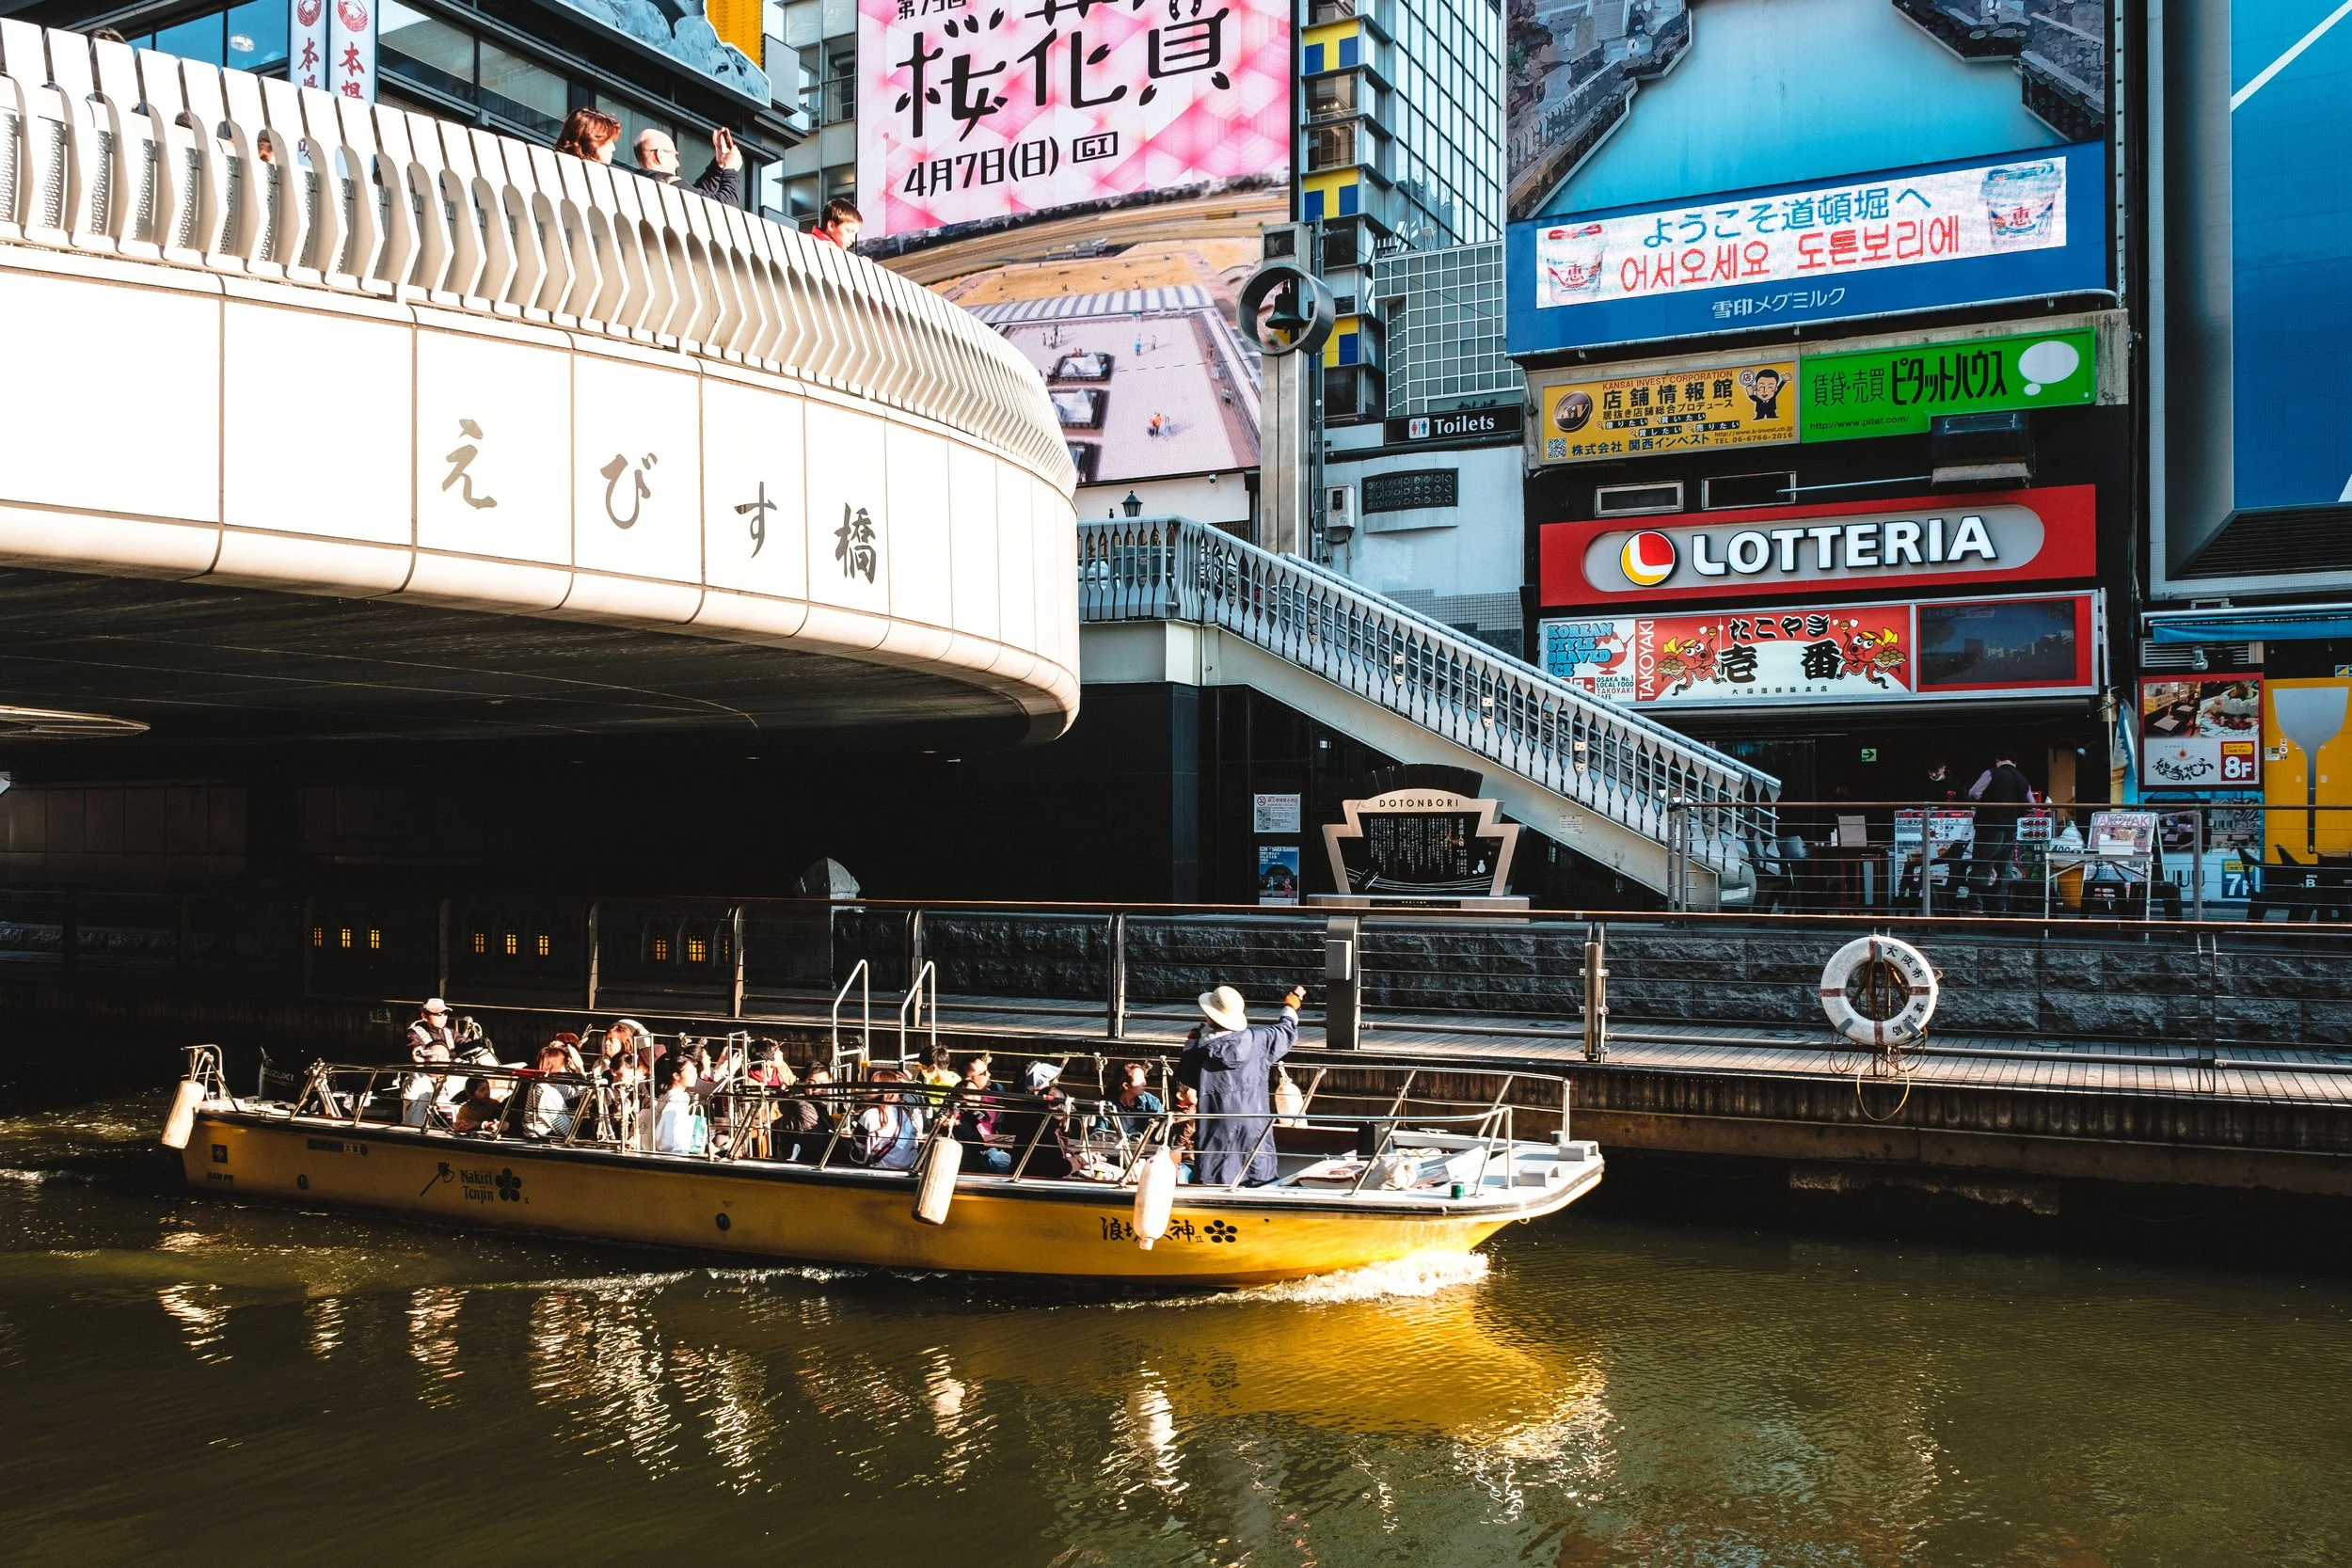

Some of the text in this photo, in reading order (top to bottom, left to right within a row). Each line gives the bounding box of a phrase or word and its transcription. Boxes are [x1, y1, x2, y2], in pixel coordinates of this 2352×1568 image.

[1642, 186, 1933, 248] ようこそ道頓堀へ
[1620, 214, 1960, 293] 어서오세요 도톤보리에
[1711, 287, 1845, 320] 雪印メグミルク
[1602, 370, 1733, 391] KANSAI INVEST CORPORATION
[1891, 349, 2008, 405] ピタットハウス
[1602, 378, 1733, 410] 店舗情報館
[1434, 415, 1495, 435] Toilets
[1714, 426, 1793, 437] http://www.k-invest.co.jp
[1809, 414, 1910, 431] http://www.pitat.com/
[1572, 434, 1709, 456] 株式会社 関西インベスト
[1732, 432, 1793, 443] 06-6766-2016
[441, 419, 877, 585] えびす橋
[1692, 515, 1998, 578] LOTTERIA
[1547, 623, 1614, 639] KOREAN
[1728, 614, 1830, 641] たこやき
[1547, 637, 1597, 652] STYLE
[1547, 649, 1613, 664] SHAVED
[1639, 620, 1655, 699] TAKOYAKI
[1547, 663, 1575, 677] ICE
[2224, 755, 2252, 779] 8F
[1379, 799, 1459, 808] DOTONBORI
[1885, 944, 1923, 979] 大阪市
[460, 1169, 493, 1185] Nakiri
[462, 1185, 494, 1205] Tenjin
